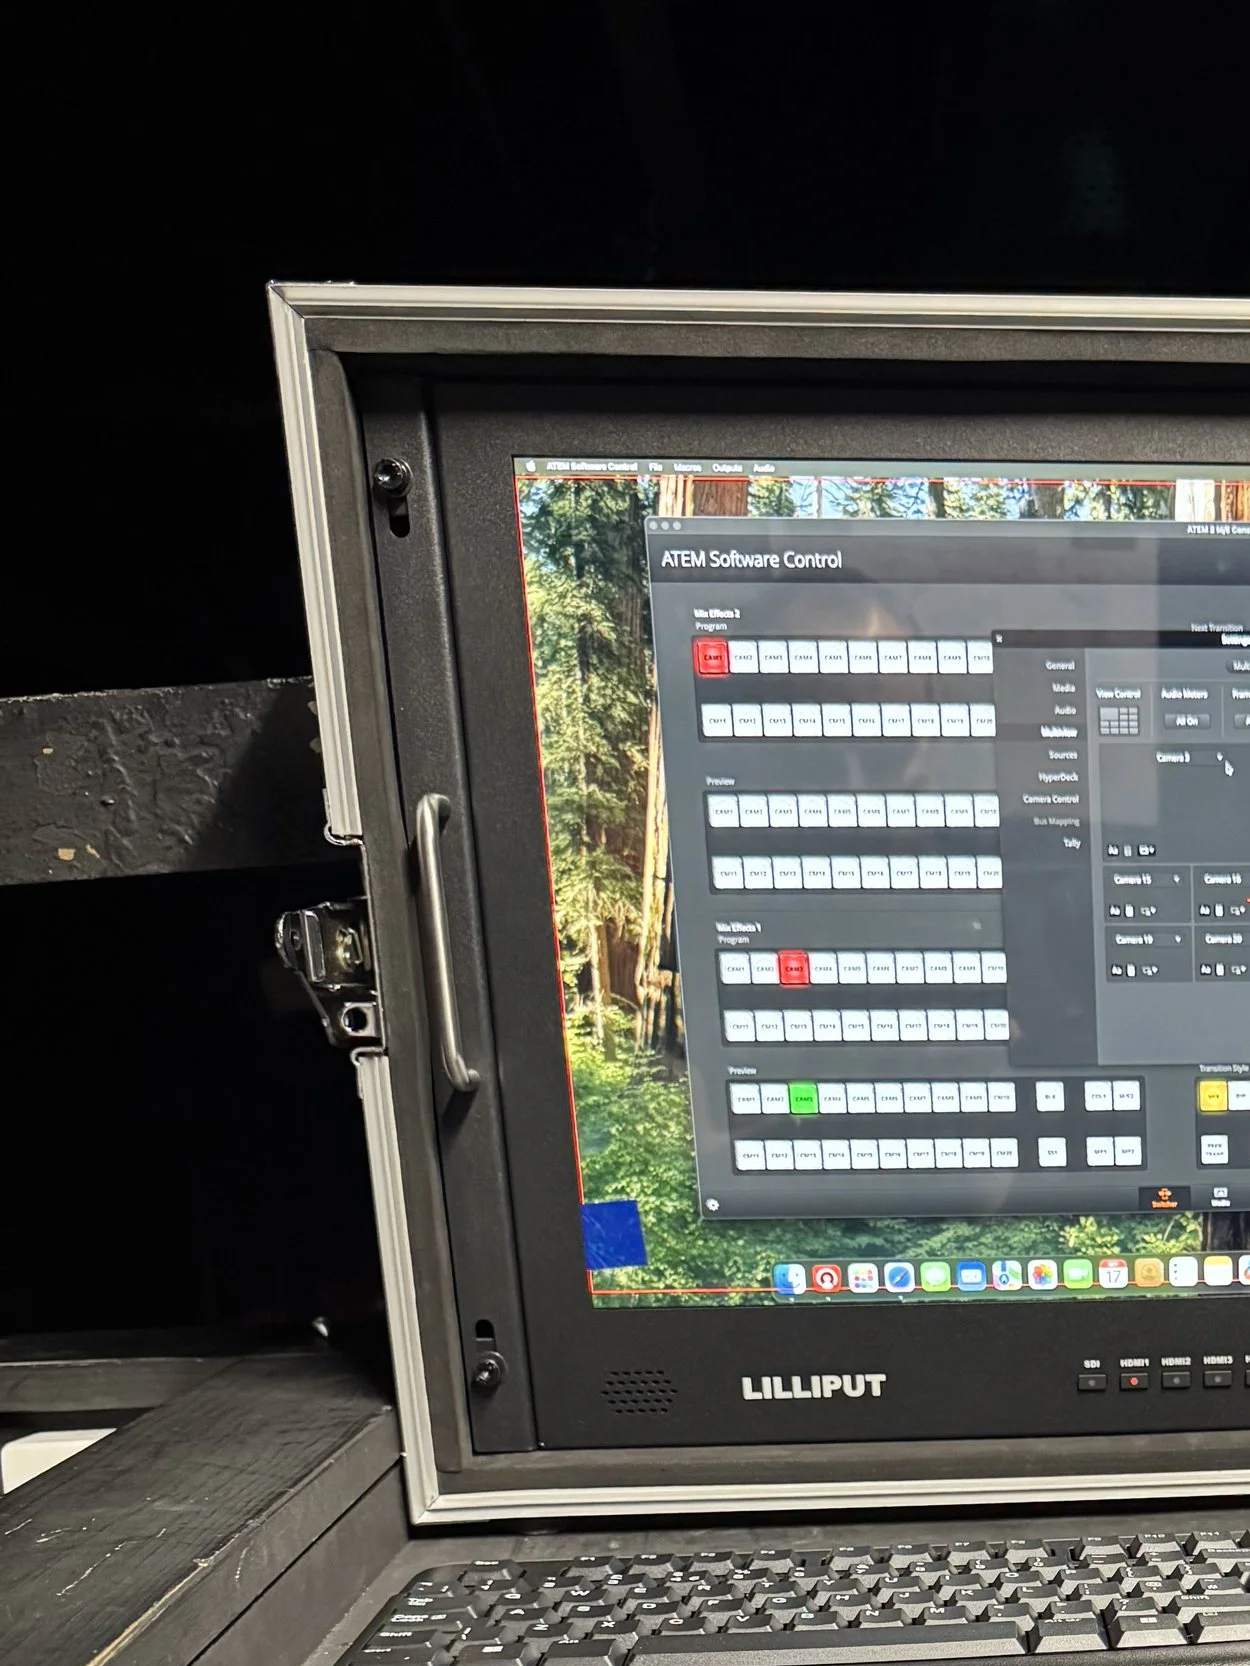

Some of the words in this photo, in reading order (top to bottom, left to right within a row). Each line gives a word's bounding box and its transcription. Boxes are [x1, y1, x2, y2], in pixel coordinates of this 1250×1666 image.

[753, 464, 775, 473] Audio
[661, 550, 706, 567] ATEM
[710, 550, 780, 568] Software
[783, 550, 842, 568] Control
[695, 622, 727, 632] Program
[1045, 660, 1075, 671] General
[1052, 683, 1076, 693] Media
[1054, 705, 1077, 715] Audio
[1049, 750, 1078, 759] Sources
[706, 777, 736, 786] Preview
[1039, 772, 1079, 783] HyperDeck
[1023, 793, 1051, 804] Camera
[1052, 794, 1080, 804] Control
[1063, 838, 1081, 849] Tally
[718, 935, 749, 946] Program
[728, 1066, 757, 1076] Preview
[1199, 1064, 1232, 1072] Transition
[1232, 1064, 1249, 1074] Style
[1107, 1270, 1121, 1283] 17
[1083, 1360, 1100, 1369] SDI
[1120, 1358, 1150, 1368] HDMI1
[1161, 1356, 1192, 1367] HDMI2
[1203, 1355, 1233, 1365] HDMI3
[741, 1373, 887, 1400] LILLIPUT
